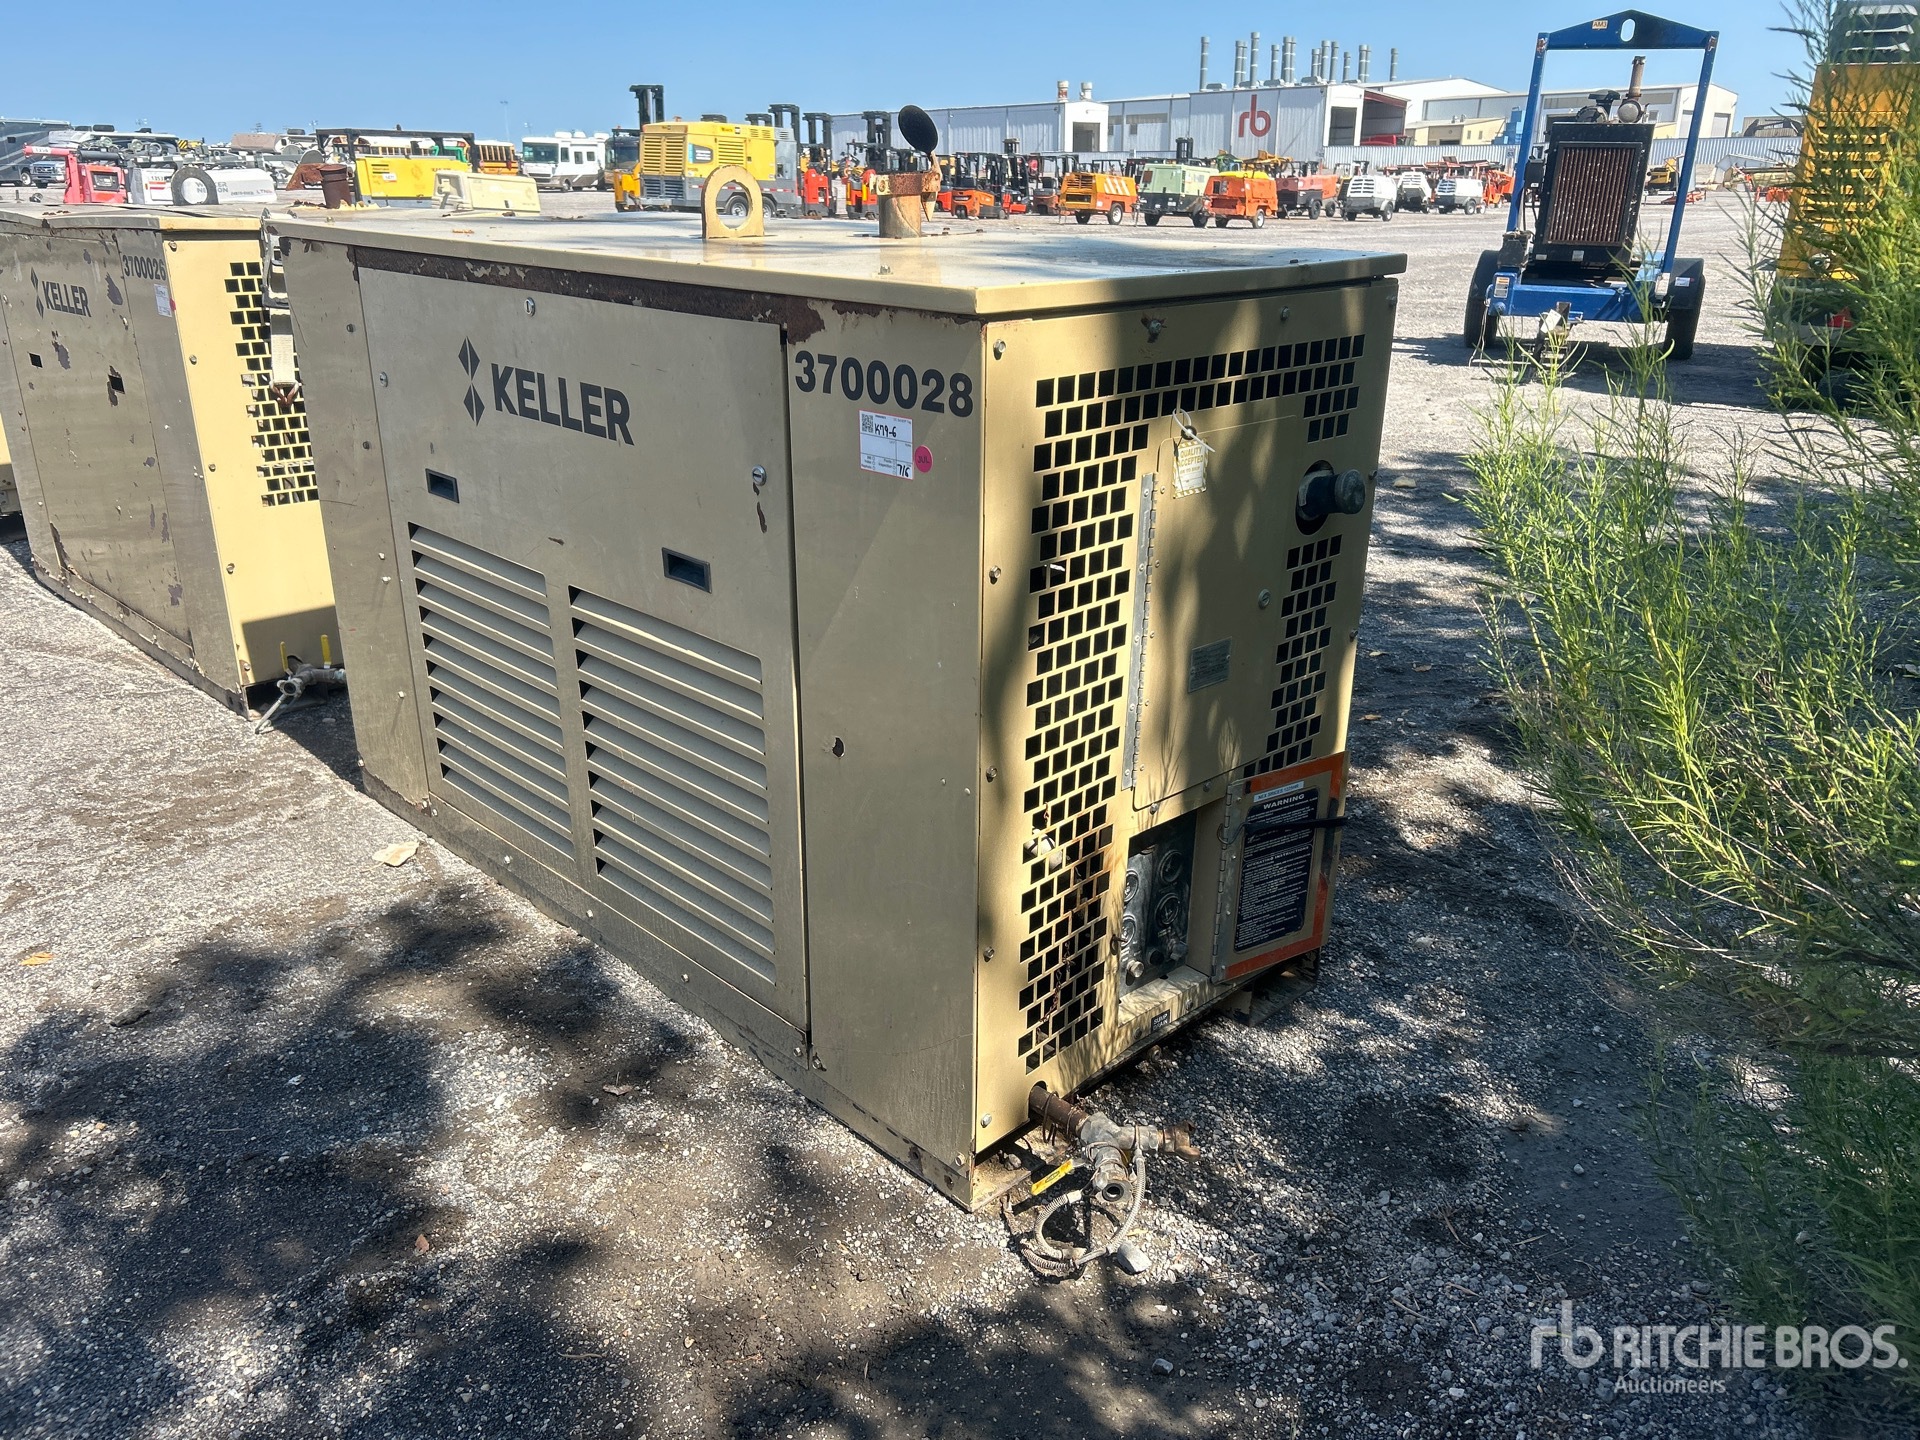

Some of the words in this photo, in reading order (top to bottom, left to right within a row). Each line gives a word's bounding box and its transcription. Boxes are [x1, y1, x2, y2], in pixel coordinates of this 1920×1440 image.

[1238, 94, 1271, 138] rb
[122, 254, 167, 281] 3700026
[42, 281, 92, 317] KELLER
[795, 350, 973, 418] 3700028
[491, 363, 634, 446] KELLER
[917, 455, 930, 464] JUL
[1180, 446, 1203, 458] QUALITY
[1263, 793, 1305, 810] WARNING
[1153, 1013, 1168, 1025] SUMP
